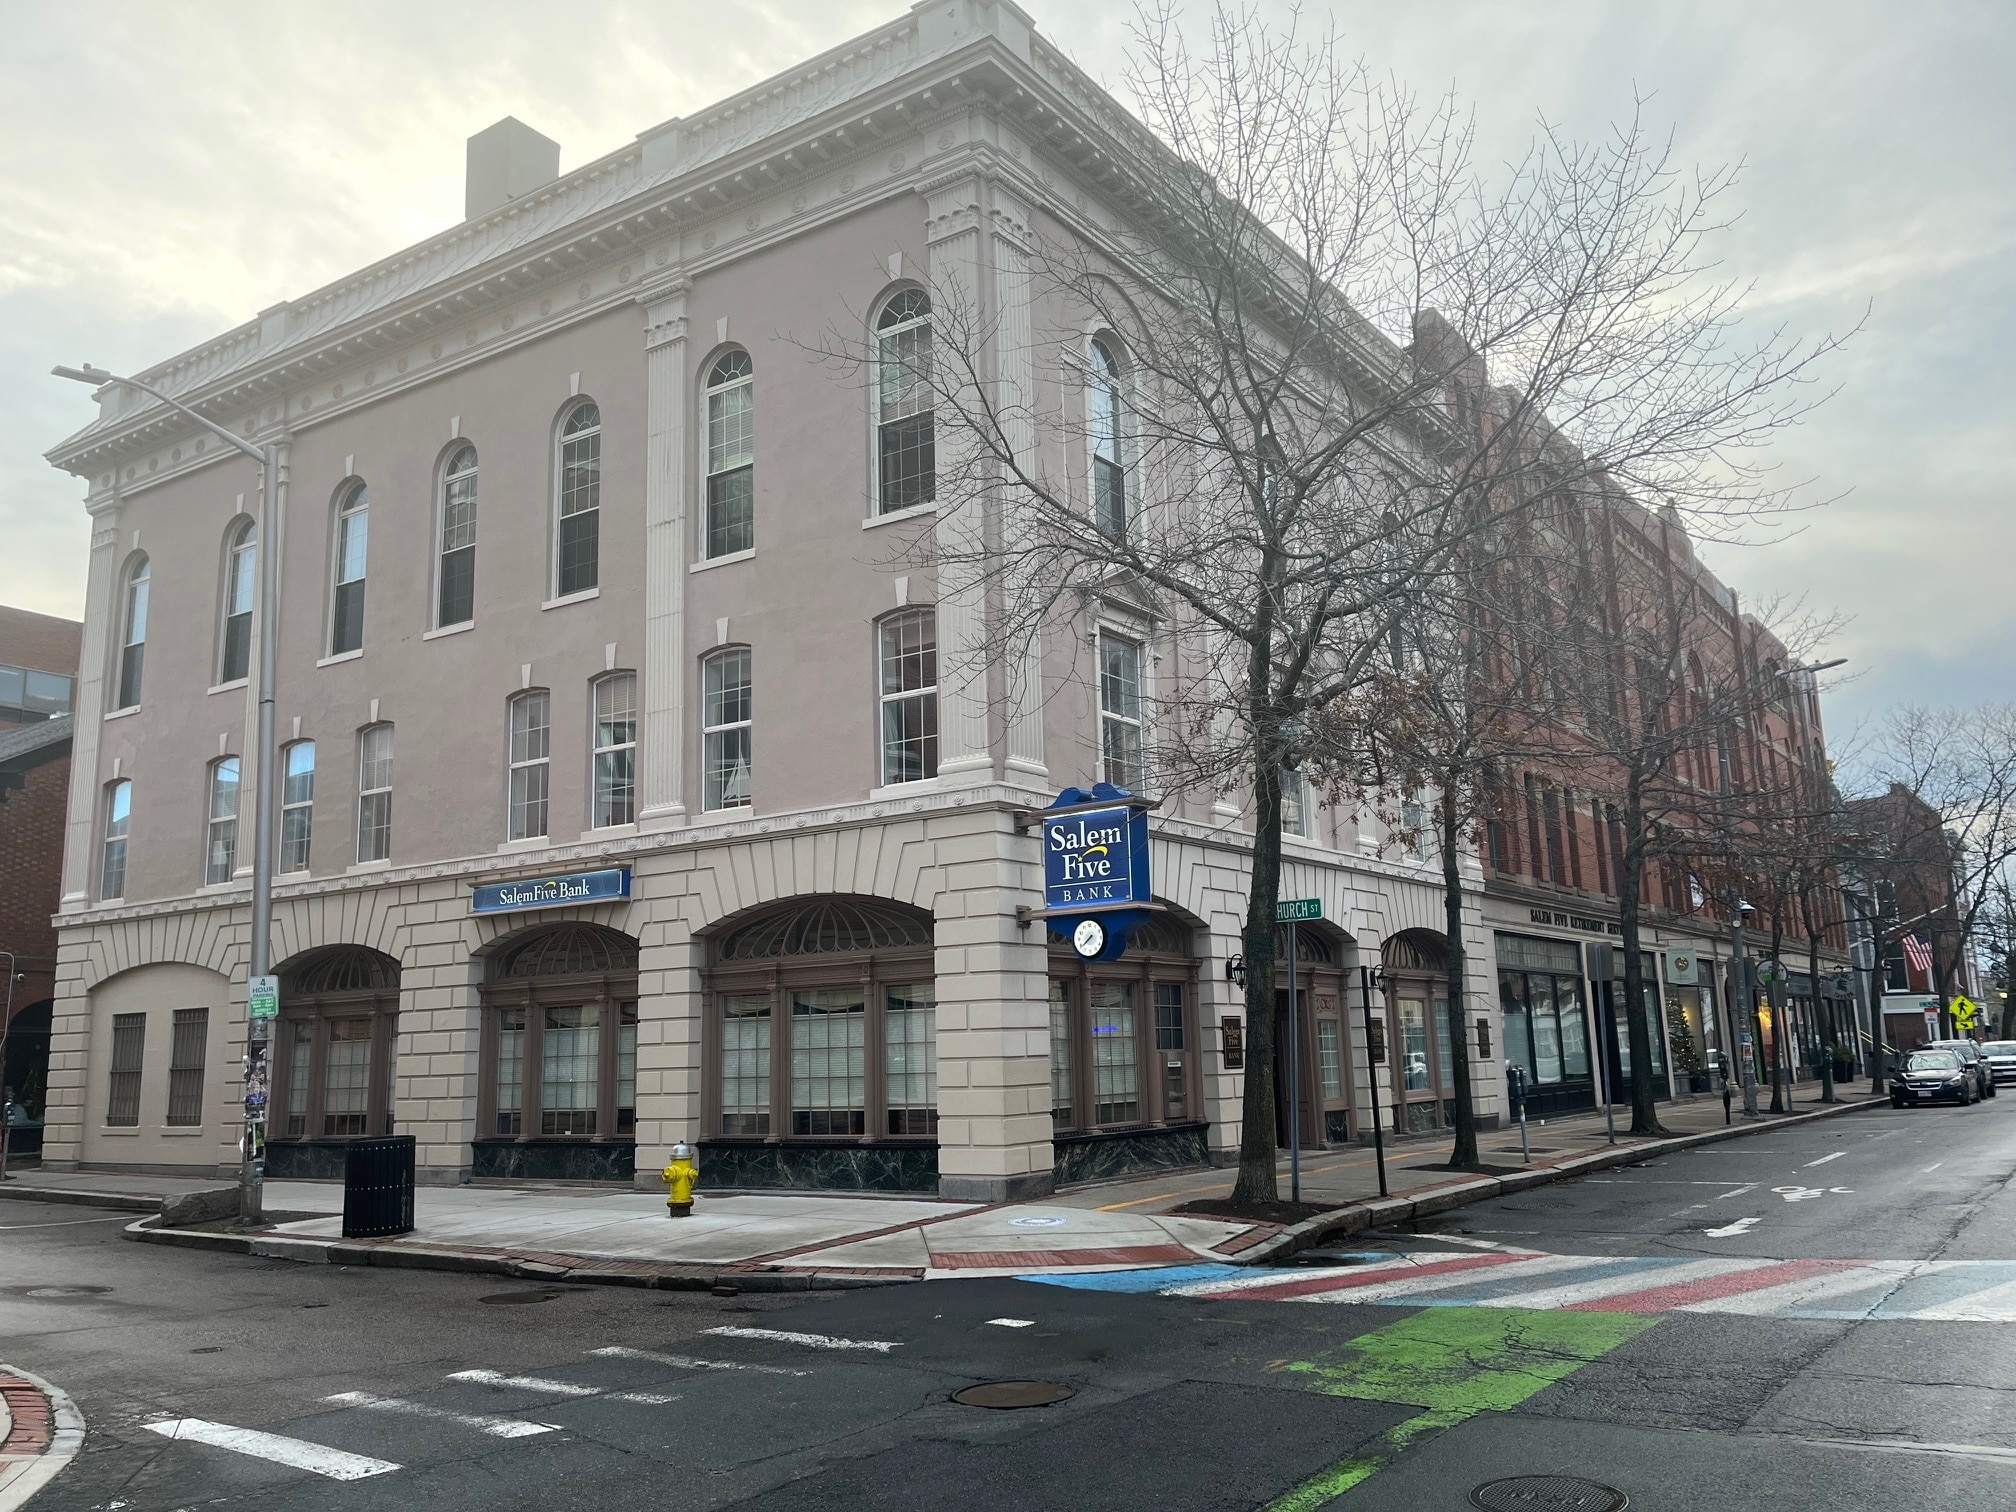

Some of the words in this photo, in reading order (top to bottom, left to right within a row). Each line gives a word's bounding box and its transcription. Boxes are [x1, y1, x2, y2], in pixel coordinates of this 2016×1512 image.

[1050, 820, 1122, 852] Salem
[1062, 853, 1111, 880] Five
[499, 887, 533, 905] Salem
[533, 884, 558, 900] Five
[559, 878, 590, 898] Bank
[1063, 885, 1113, 902] BANK
[1276, 901, 1309, 919] HURCH
[1310, 904, 1319, 913] ST
[1530, 908, 1552, 925] SALEM
[1553, 912, 1568, 927] FIVE
[259, 978, 267, 986] 4
[1225, 1025, 1240, 1036] Salem
